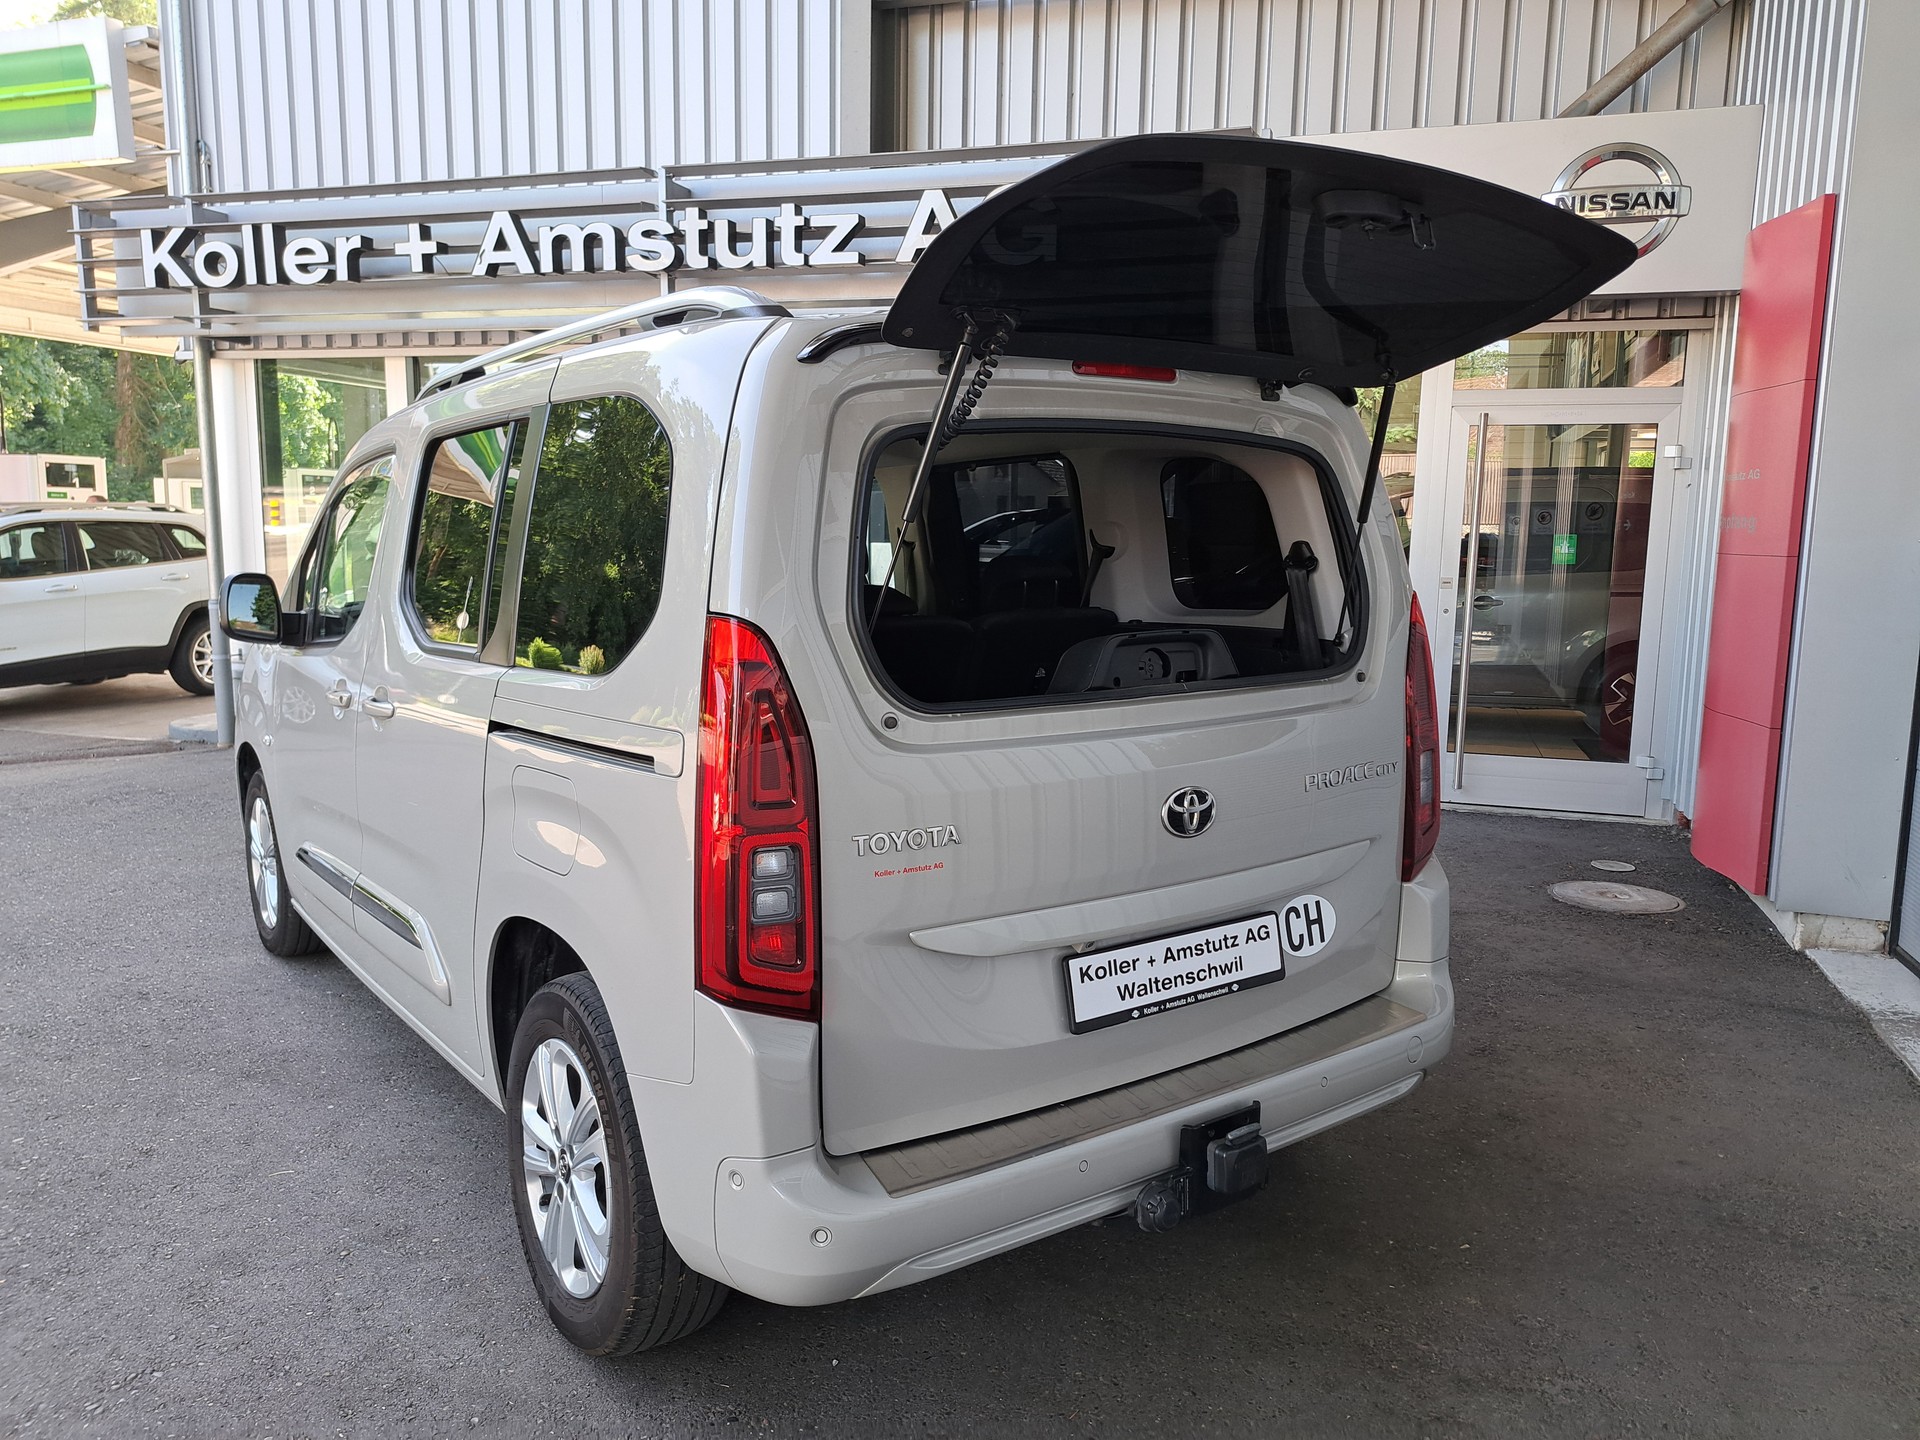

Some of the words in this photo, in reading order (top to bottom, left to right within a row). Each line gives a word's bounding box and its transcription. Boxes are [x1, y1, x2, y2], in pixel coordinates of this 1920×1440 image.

[1554, 191, 1677, 214] NISSAN
[140, 222, 365, 289] Koller
[394, 223, 440, 274] +
[471, 202, 864, 276] Amstutz
[1748, 468, 1760, 480] AG
[1304, 761, 1375, 793] PROACE
[1375, 761, 1399, 777] CITY
[851, 824, 962, 857] TOYOTA
[874, 868, 896, 878] Koller
[902, 864, 932, 874] Amstutz
[1285, 900, 1325, 953] CH
[1079, 956, 1140, 984] Koller
[1147, 955, 1157, 967] +
[1163, 933, 1240, 965] Amstutz
[1245, 924, 1271, 945] AG
[1116, 955, 1244, 1001] Waltenschwil
[1143, 1005, 1160, 1015] Koller
[1165, 997, 1187, 1009] Amstutz
[1187, 995, 1196, 1003] AG
[1196, 986, 1229, 1000] Waltenschwil
[579, 1045, 619, 1158] MICHELIN
